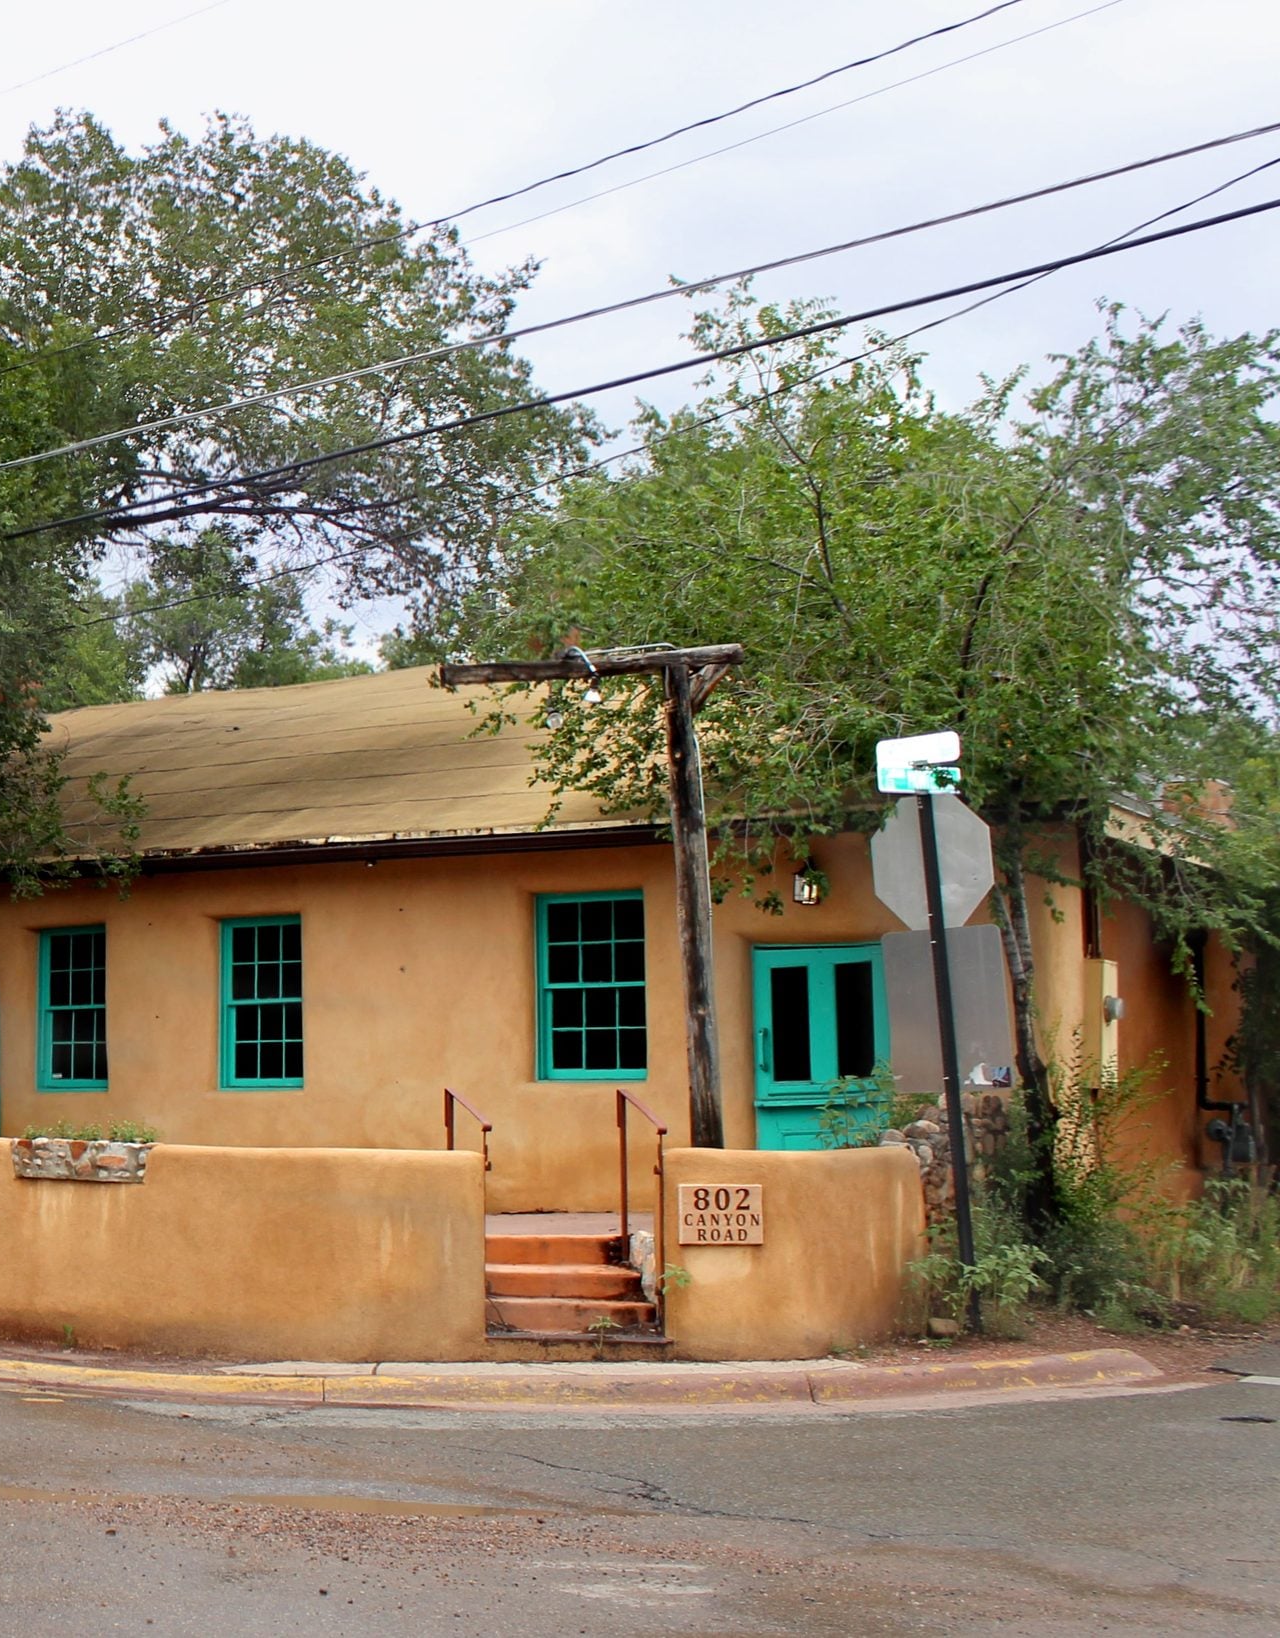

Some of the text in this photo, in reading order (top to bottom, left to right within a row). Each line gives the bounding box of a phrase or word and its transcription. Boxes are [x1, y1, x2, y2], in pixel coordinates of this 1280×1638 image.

[693, 1188, 750, 1211] 802
[684, 1213, 760, 1226] CANYON
[697, 1228, 748, 1241] ROAD
